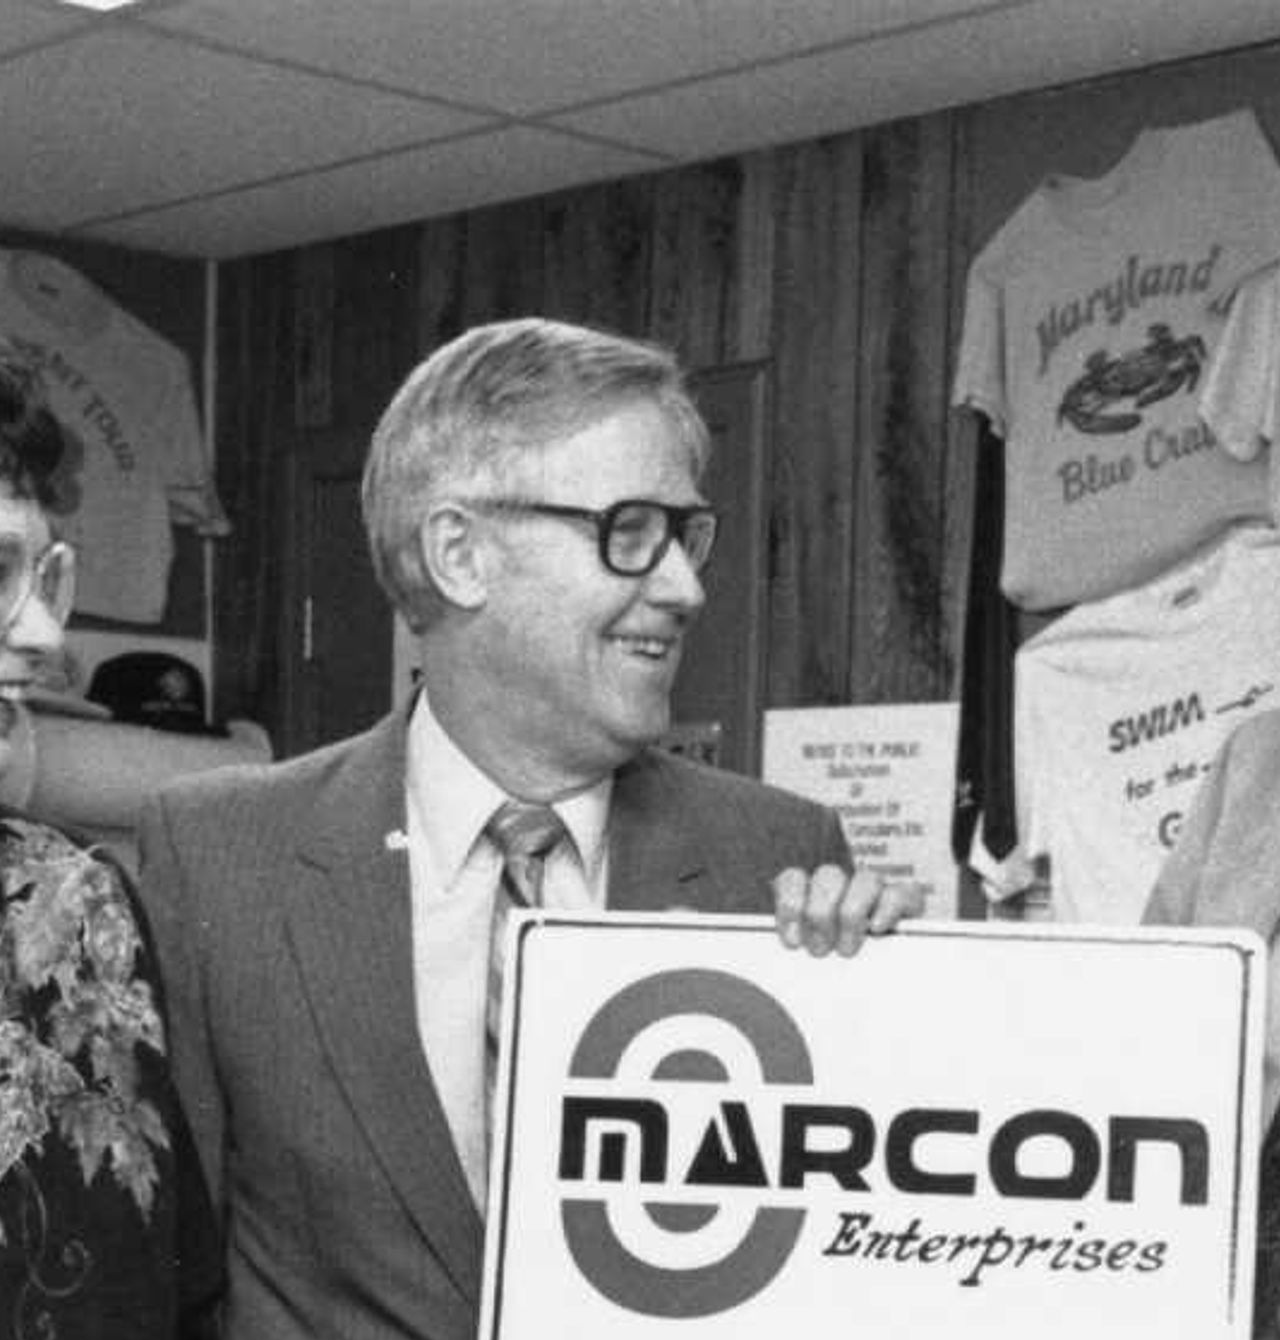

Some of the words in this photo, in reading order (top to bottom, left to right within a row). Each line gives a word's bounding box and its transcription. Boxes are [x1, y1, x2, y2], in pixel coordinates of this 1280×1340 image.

[1035, 243, 1222, 377] Maryland
[1057, 454, 1137, 504] Blue
[1108, 691, 1205, 753] SWIM
[1125, 778, 1154, 803] for
[1166, 762, 1198, 787] the
[558, 1096, 1210, 1207] MARCON
[821, 1209, 1167, 1287] Enterprises
